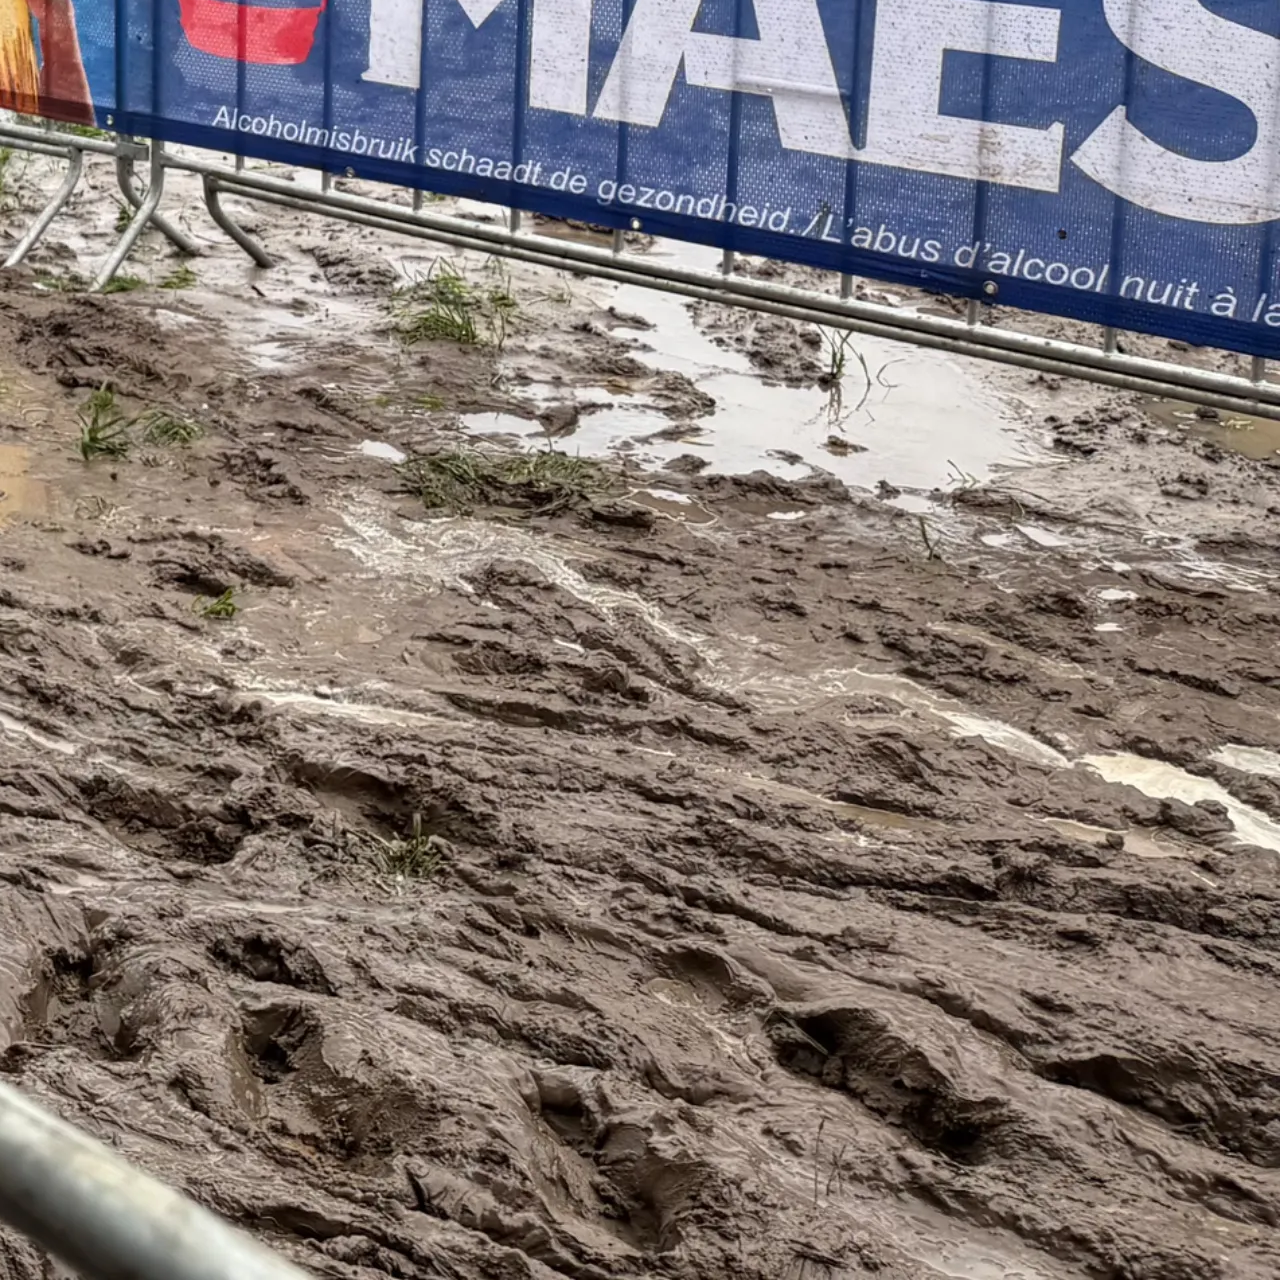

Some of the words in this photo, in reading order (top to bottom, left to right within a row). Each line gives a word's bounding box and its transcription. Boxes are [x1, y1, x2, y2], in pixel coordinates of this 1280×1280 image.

[211, 104, 419, 163] Alcoholmisbruik
[425, 147, 543, 186] schaadt
[549, 166, 588, 194] de
[954, 240, 1110, 293] d'alcool
[1119, 274, 1200, 311] nuit
[1210, 285, 1238, 318] à
